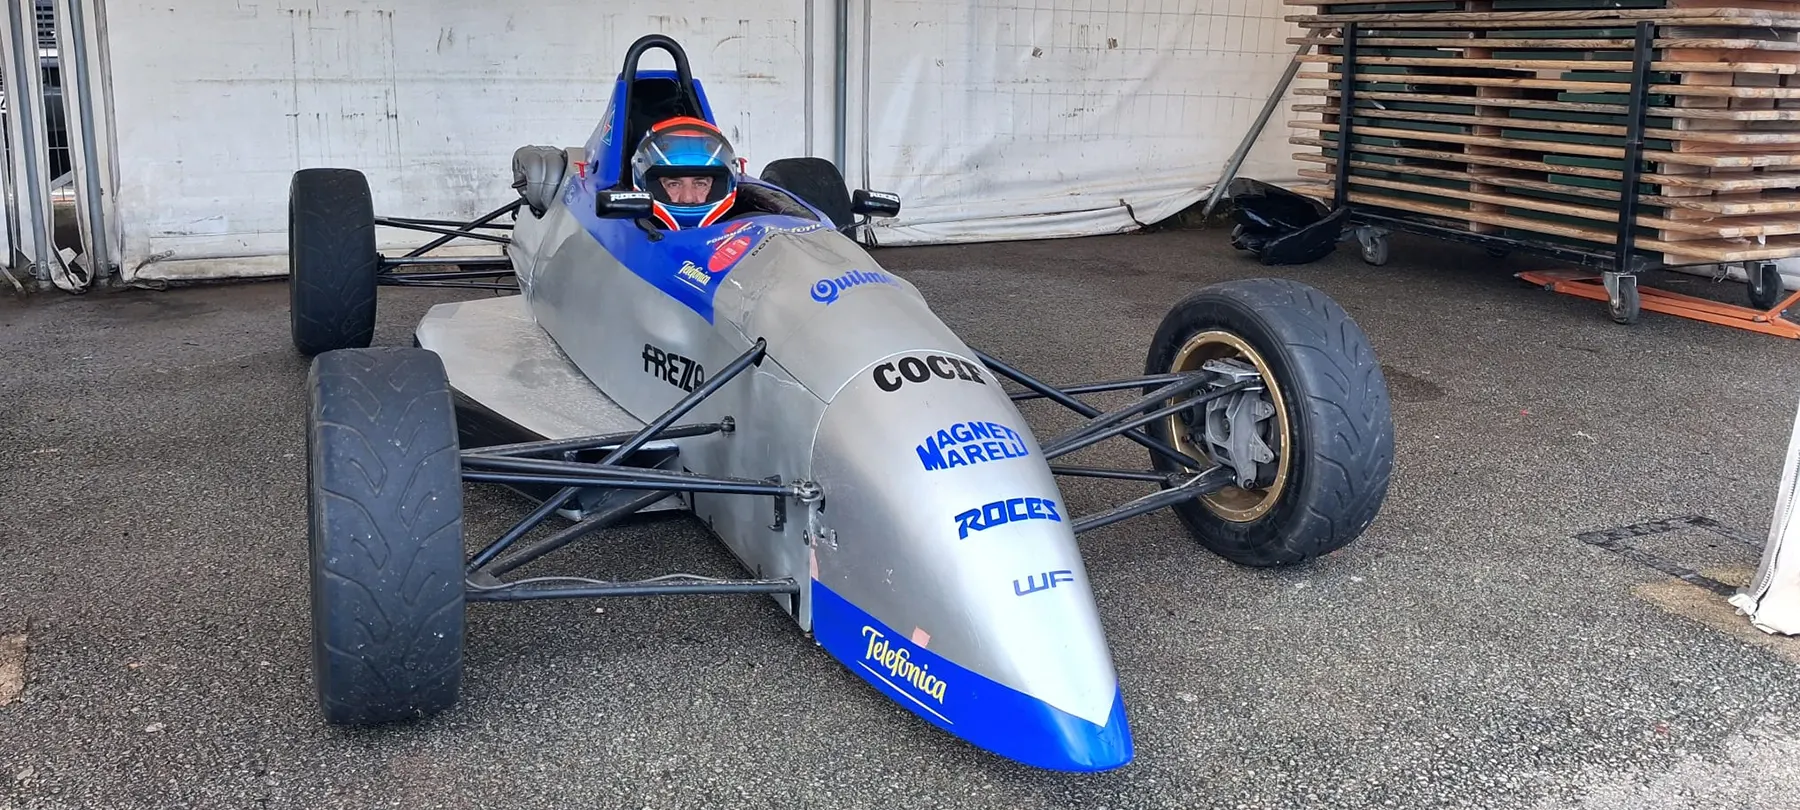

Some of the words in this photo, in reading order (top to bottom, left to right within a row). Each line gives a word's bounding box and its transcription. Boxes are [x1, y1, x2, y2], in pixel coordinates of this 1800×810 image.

[751, 232, 779, 257] DOIM
[810, 269, 902, 306] Quilm
[873, 355, 987, 392] COCIF
[954, 497, 1061, 540] ROCES
[862, 625, 947, 705] Telefonica
